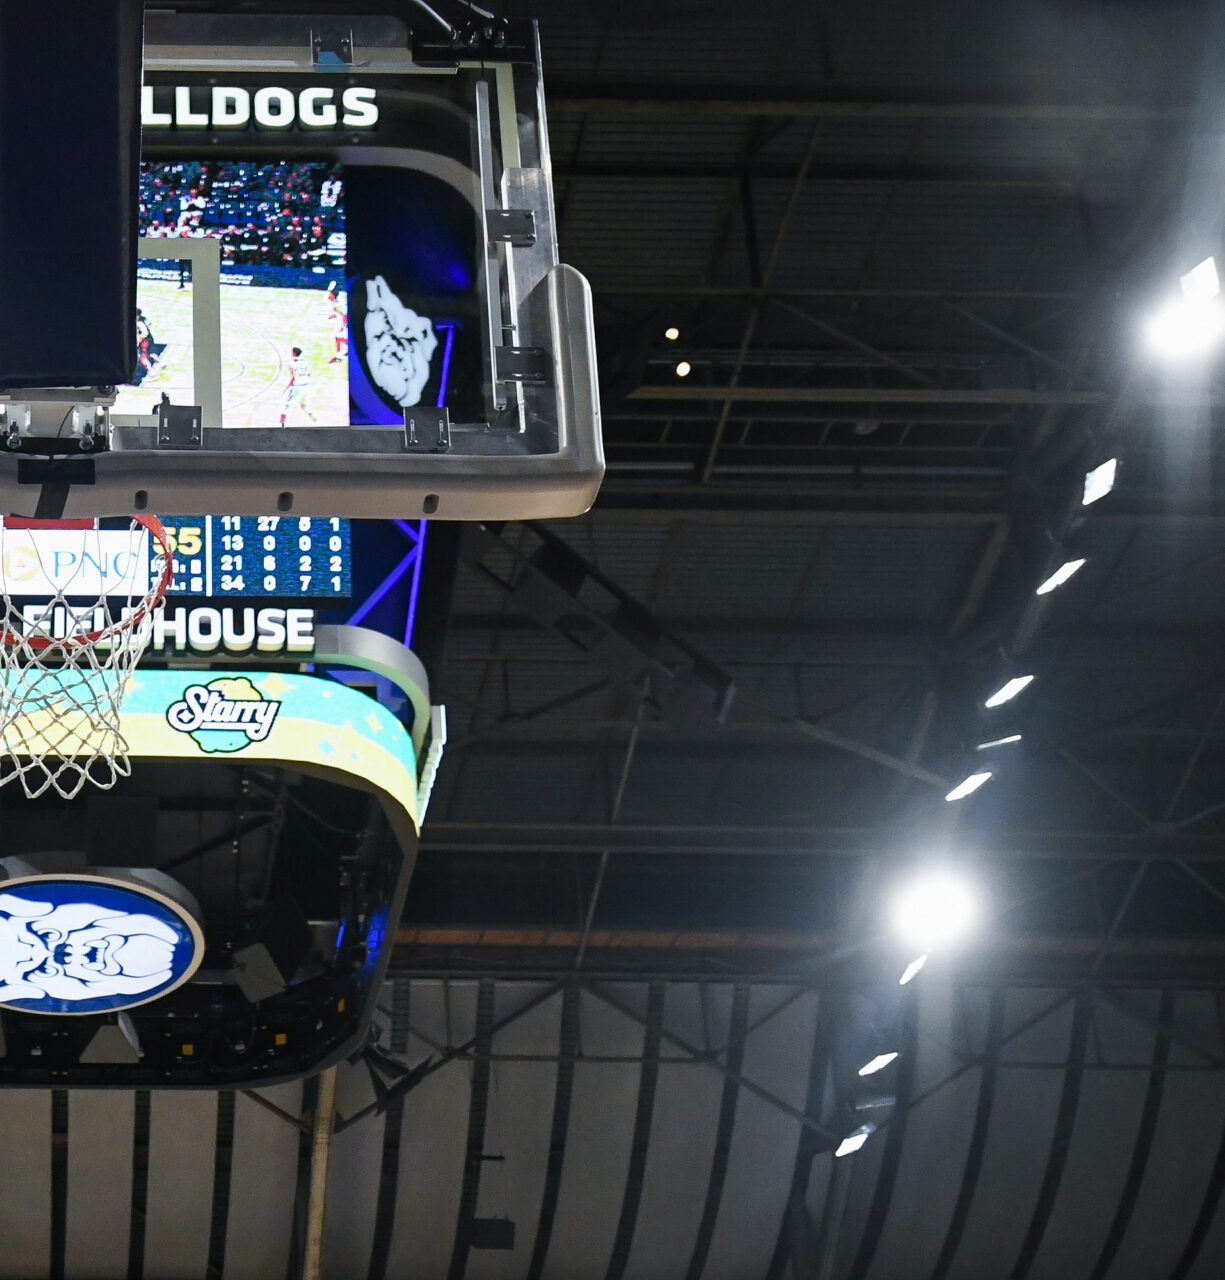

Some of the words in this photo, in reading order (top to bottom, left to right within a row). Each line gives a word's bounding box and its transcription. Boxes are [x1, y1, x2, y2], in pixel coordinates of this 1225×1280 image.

[141, 86, 378, 127] LLDOGS
[221, 516, 241, 530] 11
[257, 516, 280, 531] 27
[329, 517, 339, 531] 1
[153, 527, 202, 555] 55
[221, 535, 244, 550] 13
[263, 535, 276, 551] 0
[299, 535, 311, 551] 0
[329, 536, 342, 552] 0
[53, 551, 137, 578] PNC
[221, 555, 242, 571] 21
[299, 555, 312, 571] 2
[330, 556, 342, 571] 2
[220, 575, 245, 590] 34
[263, 575, 276, 591] 0
[299, 576, 311, 591] 7
[331, 576, 341, 591] 1
[167, 683, 280, 741] Starry
